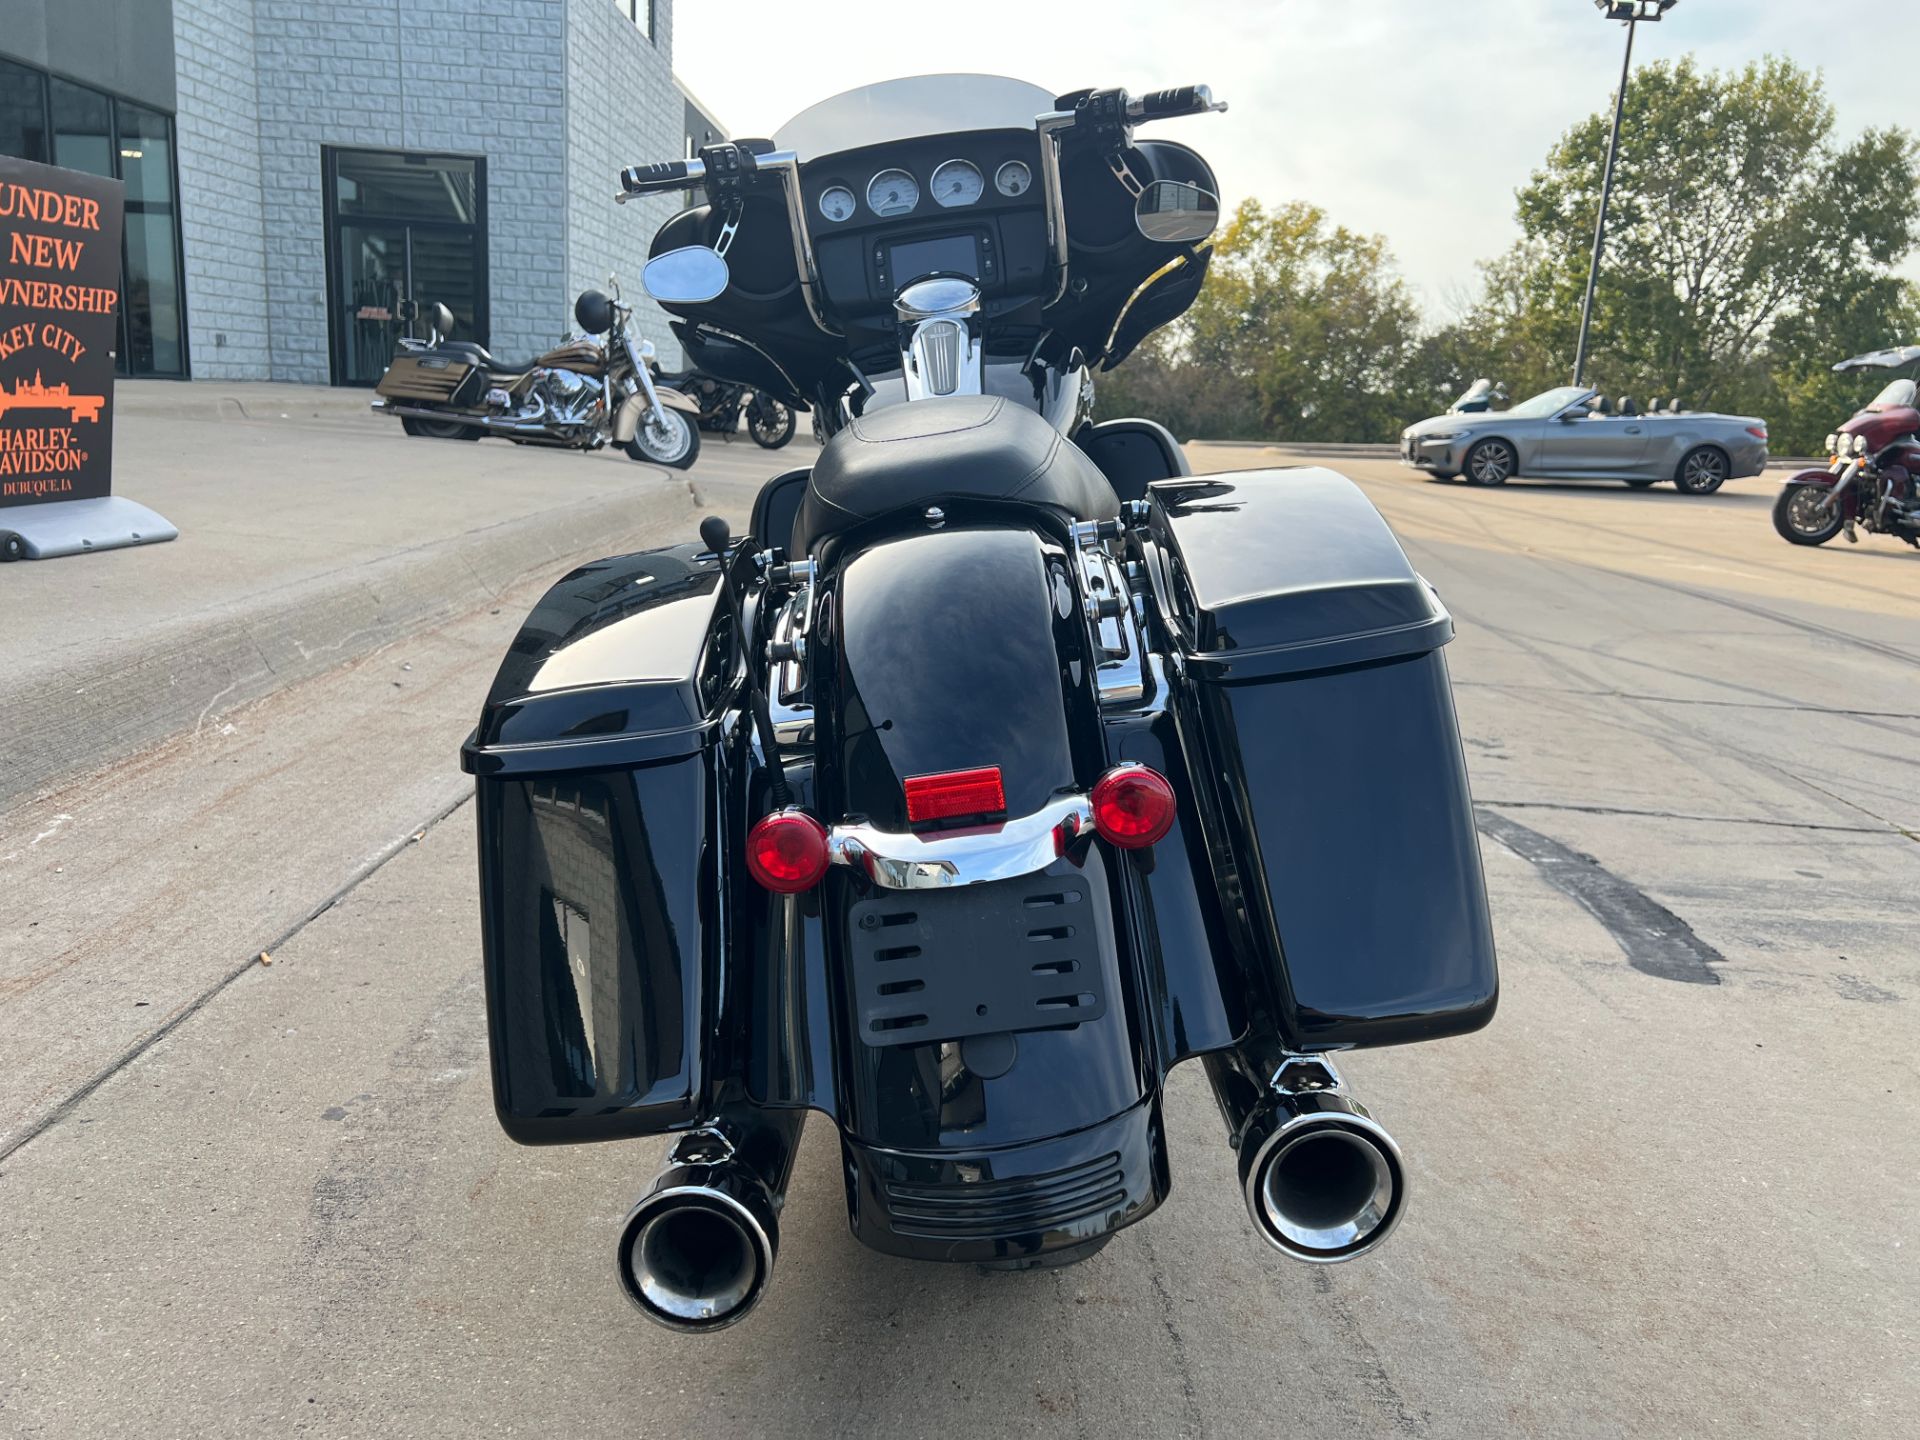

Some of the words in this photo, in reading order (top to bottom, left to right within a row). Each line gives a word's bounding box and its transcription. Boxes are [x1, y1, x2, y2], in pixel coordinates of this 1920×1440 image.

[0, 182, 100, 231] UNDER
[9, 232, 84, 271] NEW
[0, 322, 36, 360] KEY
[42, 323, 86, 364] CITY
[0, 428, 78, 452] HARLEY-
[61, 478, 72, 491] IA
